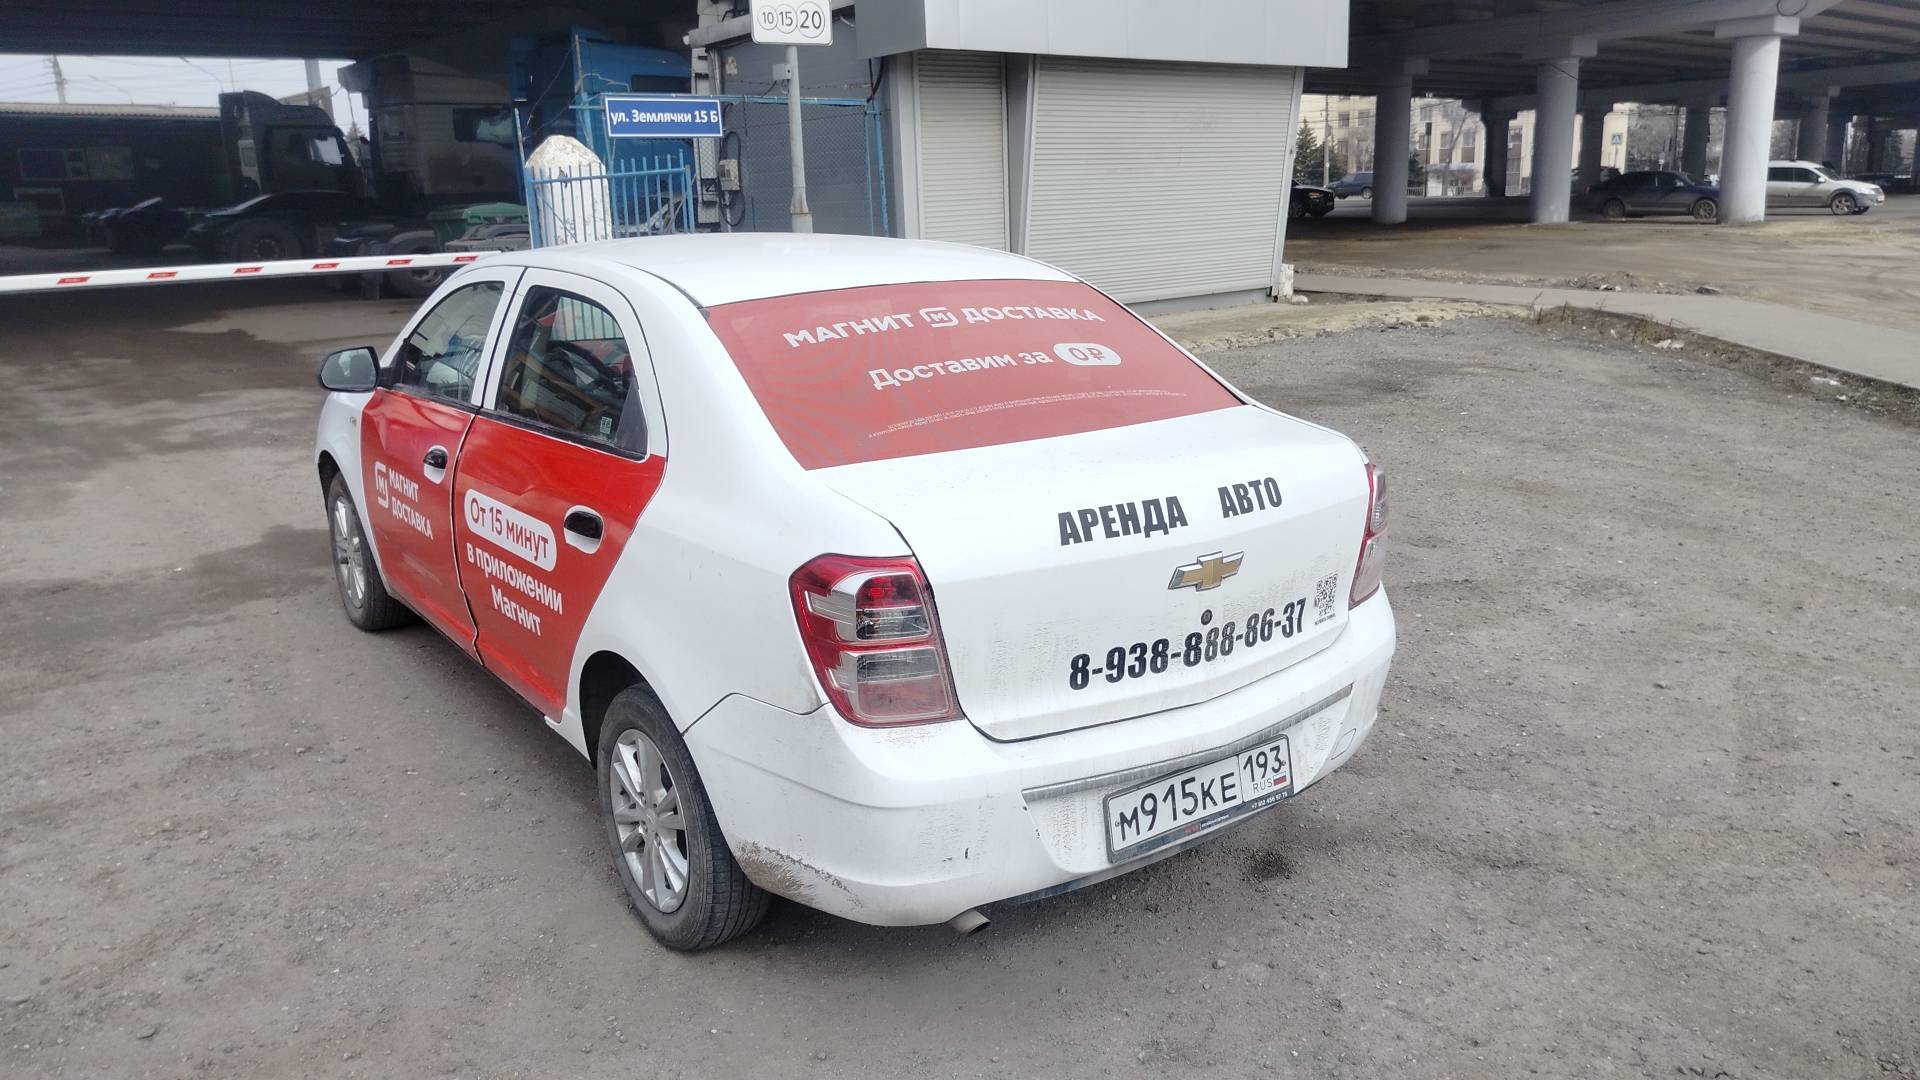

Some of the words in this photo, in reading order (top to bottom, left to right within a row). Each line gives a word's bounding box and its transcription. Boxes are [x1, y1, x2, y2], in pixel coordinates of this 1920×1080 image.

[762, 11, 774, 25] 10
[779, 11, 793, 27] 15
[800, 10, 822, 30] 20
[610, 111, 629, 125] ул.
[632, 109, 692, 123] Землячки
[694, 110, 708, 123] 15
[710, 110, 718, 123] Б
[783, 312, 914, 347] МАГНИТ
[960, 306, 1105, 324] ДОСТАВКА
[868, 353, 1018, 391] Доставим
[1018, 351, 1054, 365] за
[389, 467, 419, 503] МАГНИТ
[391, 496, 434, 540] ДОСТАВКА
[470, 497, 486, 528] От
[489, 505, 503, 537] 15
[505, 519, 549, 562] минут
[1057, 495, 1189, 546] АРЕНДА
[1217, 476, 1283, 519] АВТО
[466, 542, 475, 564] в
[477, 550, 563, 615] приложении
[490, 584, 541, 636] Магнит
[1068, 597, 1307, 691] 8-938-888-86-37
[1243, 745, 1282, 783] 193
[1252, 777, 1273, 794] RUS
